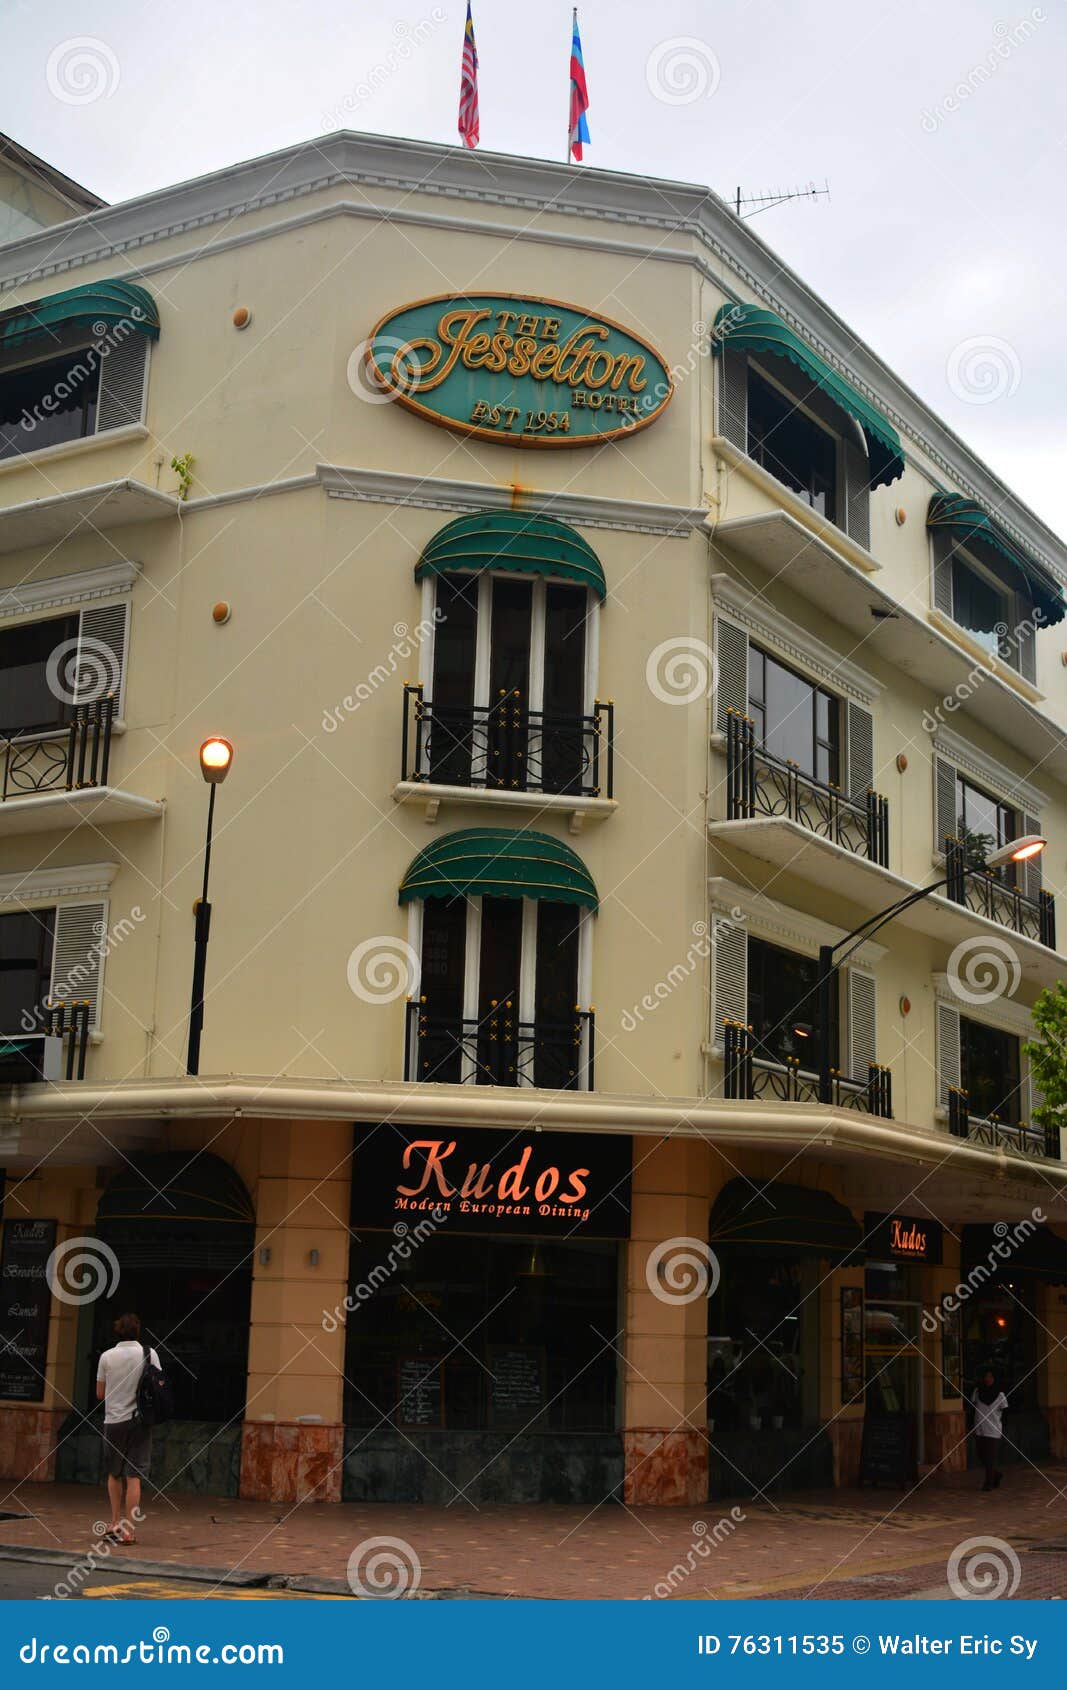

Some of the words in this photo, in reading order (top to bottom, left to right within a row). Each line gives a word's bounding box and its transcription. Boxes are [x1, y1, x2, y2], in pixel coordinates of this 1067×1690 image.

[496, 310, 562, 340] THE
[391, 307, 648, 392] Jesselton
[470, 400, 521, 428] EST
[525, 410, 570, 433] 1954
[572, 390, 643, 414] HOTEL
[396, 1140, 591, 1204] Kudos
[394, 1197, 451, 1212] Modern
[459, 1200, 531, 1218] European
[538, 1203, 591, 1222] Dining
[890, 1219, 928, 1251] Kudos
